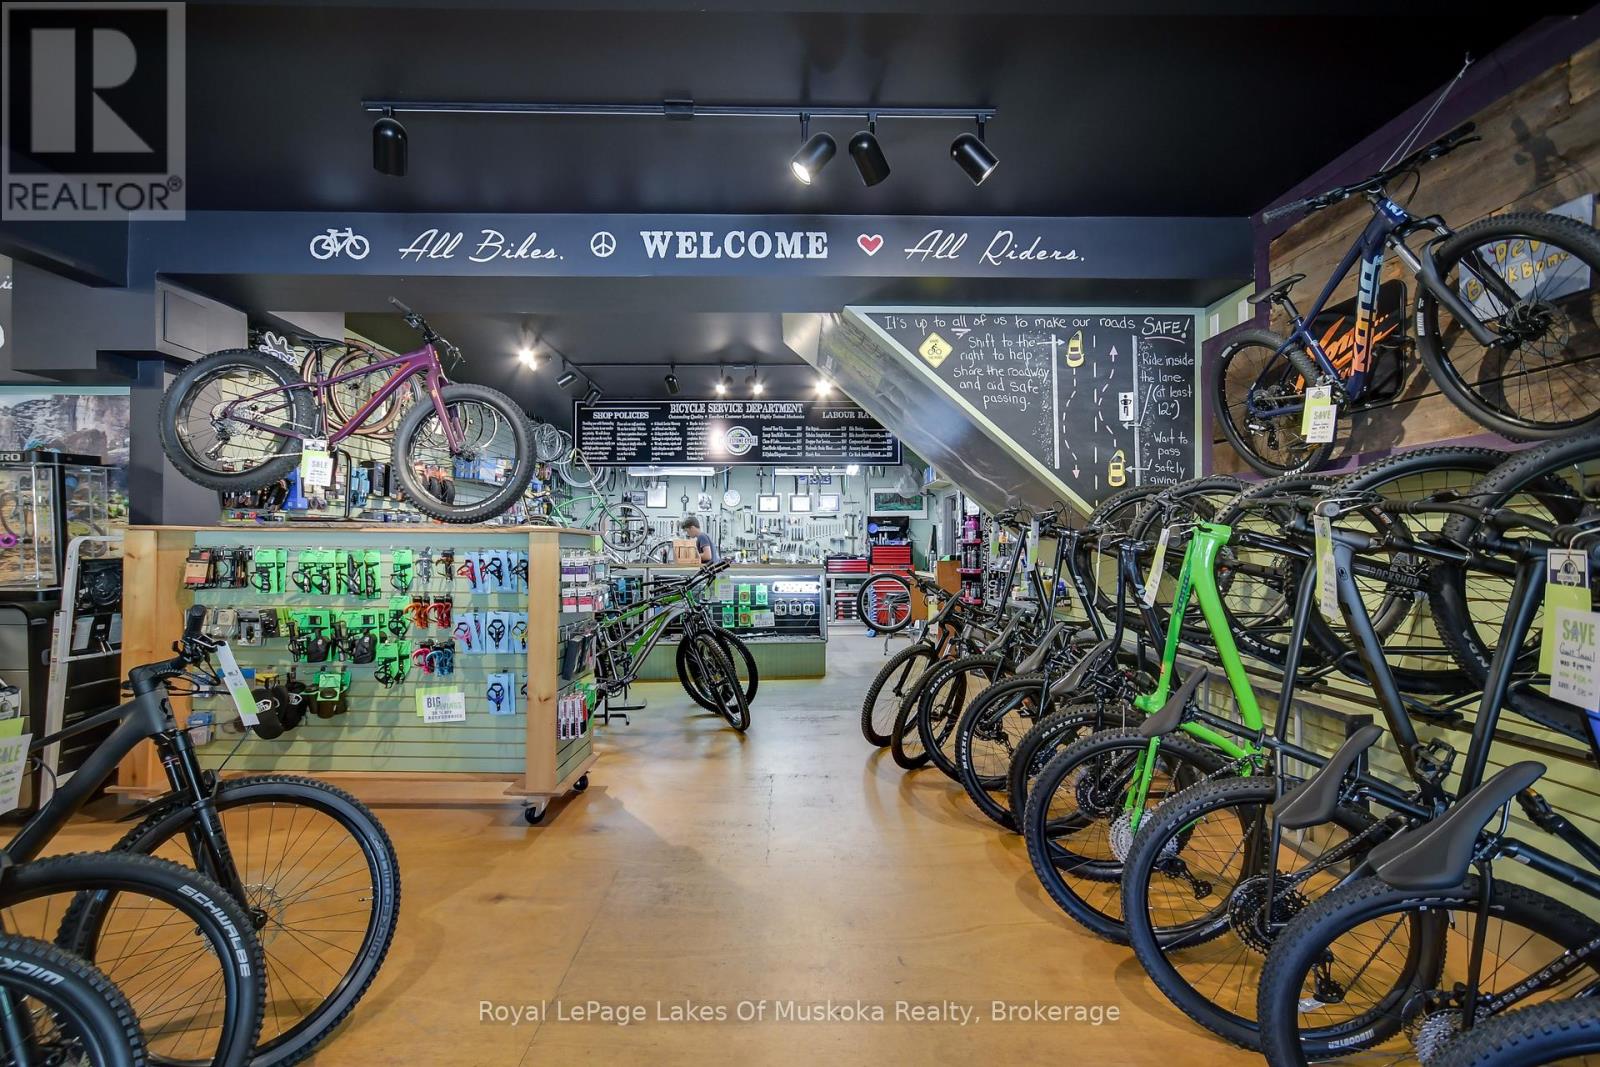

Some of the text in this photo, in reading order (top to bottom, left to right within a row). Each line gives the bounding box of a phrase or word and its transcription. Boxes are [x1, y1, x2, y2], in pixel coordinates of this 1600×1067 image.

[398, 228, 1086, 266] All Bikes. WELCOME All Riders.
[1351, 257, 1377, 377] KONA
[884, 314, 1191, 339] It's up to all of us to make our roads SAFE!
[968, 332, 1036, 348] Shift to the
[960, 347, 1033, 369] right to help
[1142, 351, 1194, 366] Ride inside
[986, 364, 1005, 377] the
[1007, 366, 1050, 384] roadway
[1140, 369, 1185, 383] the lane.
[960, 376, 1039, 394] and aid safe
[1152, 384, 1193, 402] (at least
[669, 403, 804, 414] BICYCLE SERVICE DEPARTMENT
[983, 392, 1031, 412] passing.
[592, 411, 650, 420] SHOP POLICIES
[822, 411, 855, 419] LABOUR
[1153, 427, 1189, 445] Wait to
[1157, 447, 1181, 460] pass
[1155, 460, 1186, 479] safely
[1150, 474, 1178, 486] giving
[1562, 619, 1596, 646] SAVE
[929, 669, 954, 694] MAXXIS
[426, 696, 441, 709] BIG
[1041, 716, 1084, 739] MAXXIS
[177, 884, 251, 978] SCHWALBE
[0, 955, 65, 986] WICK
